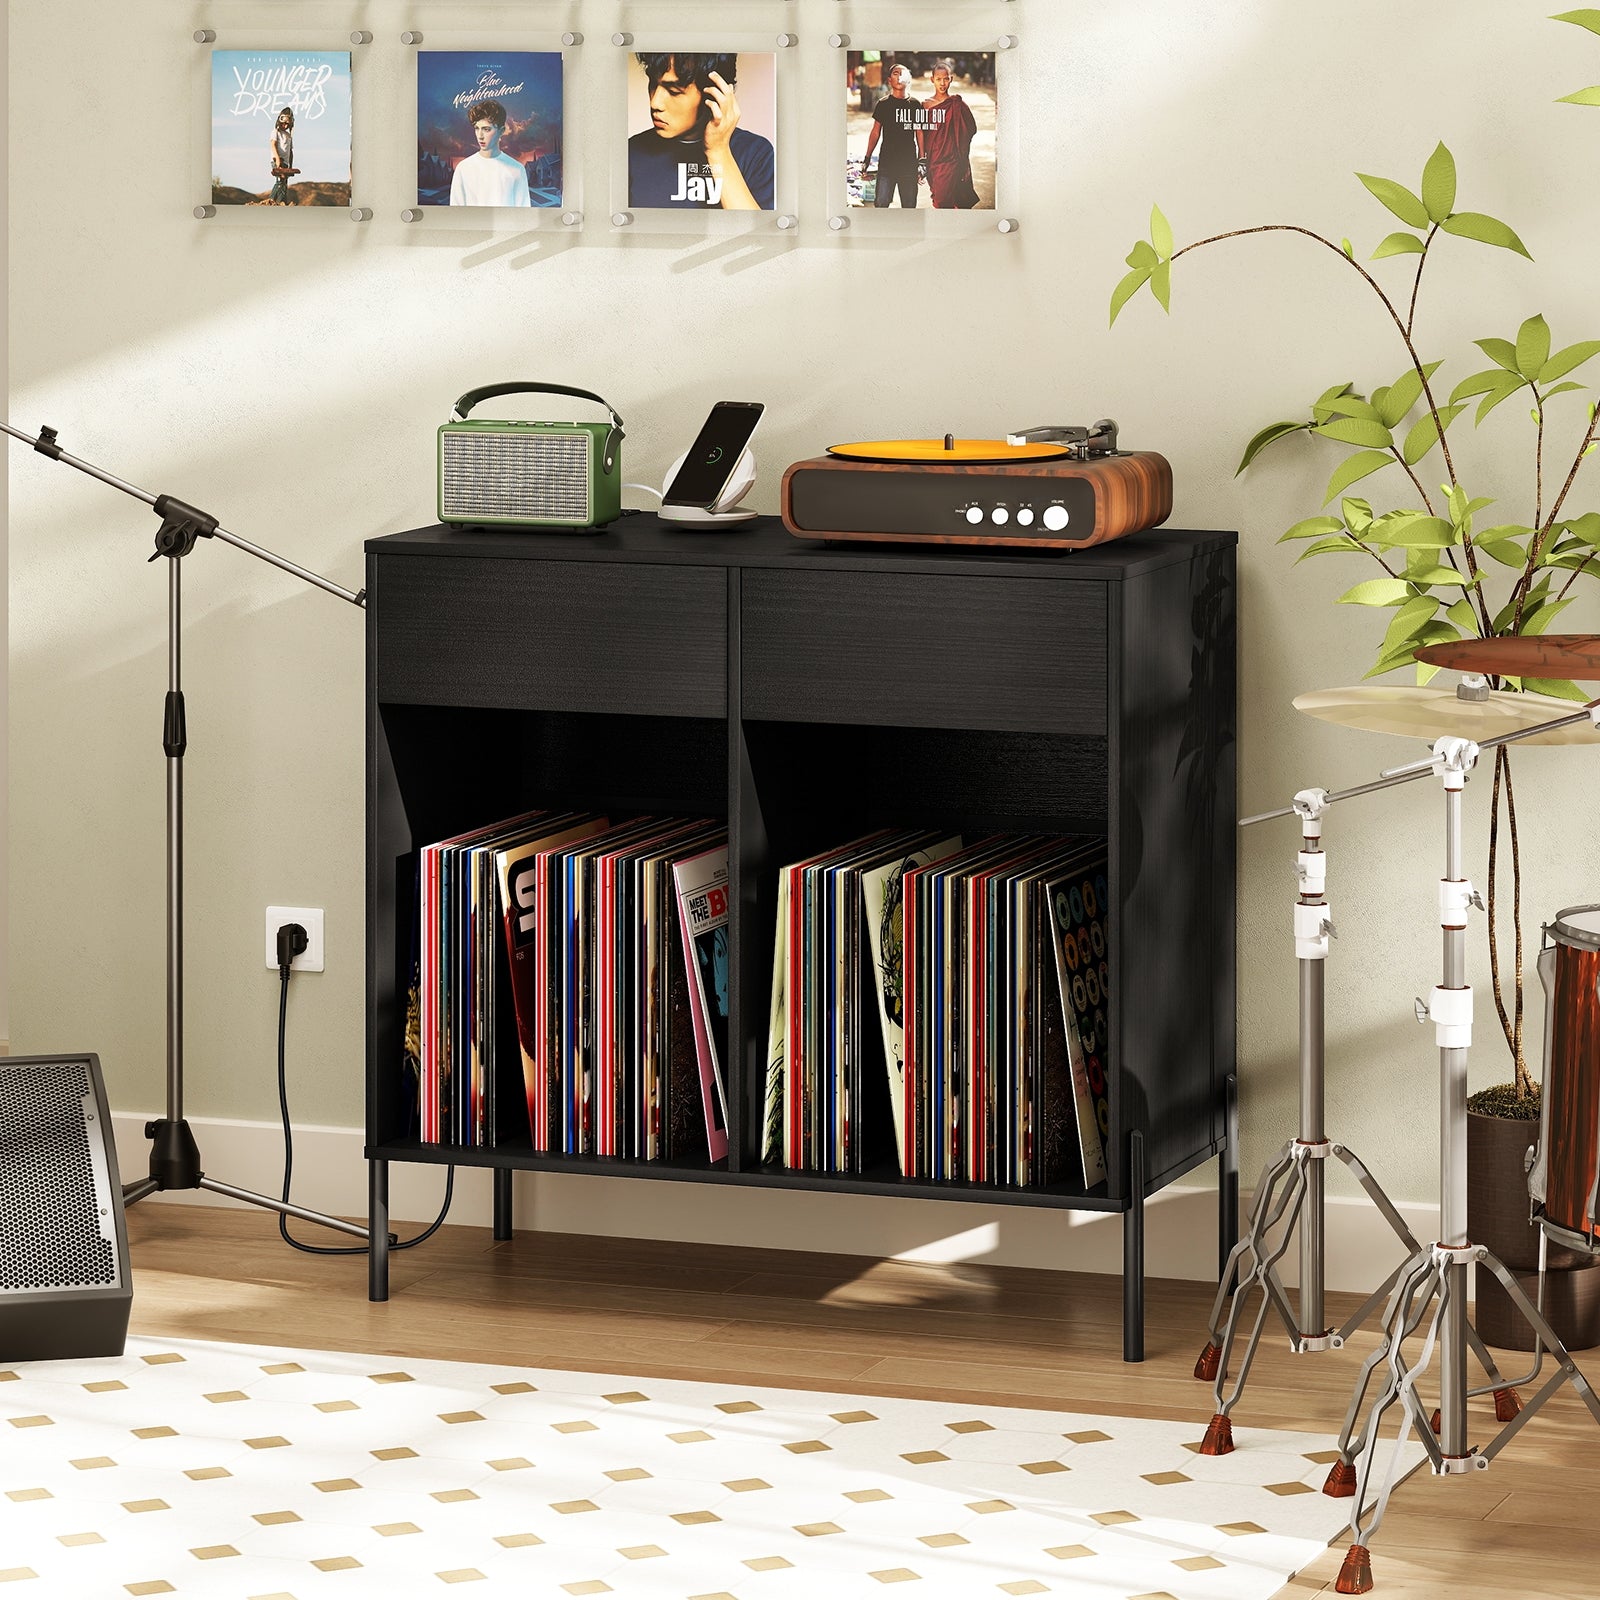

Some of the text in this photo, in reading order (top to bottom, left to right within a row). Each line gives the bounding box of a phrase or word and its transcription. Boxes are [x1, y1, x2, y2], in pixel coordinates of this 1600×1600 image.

[233, 64, 332, 94] YOUNGER
[476, 69, 502, 90] Blue
[229, 91, 328, 120] DREAMS
[452, 82, 524, 109] Neighbourhood
[896, 108, 946, 123] FALL OUT BOY
[670, 163, 723, 204] Jay
[689, 894, 707, 910] MEET
[691, 907, 710, 924] THE
